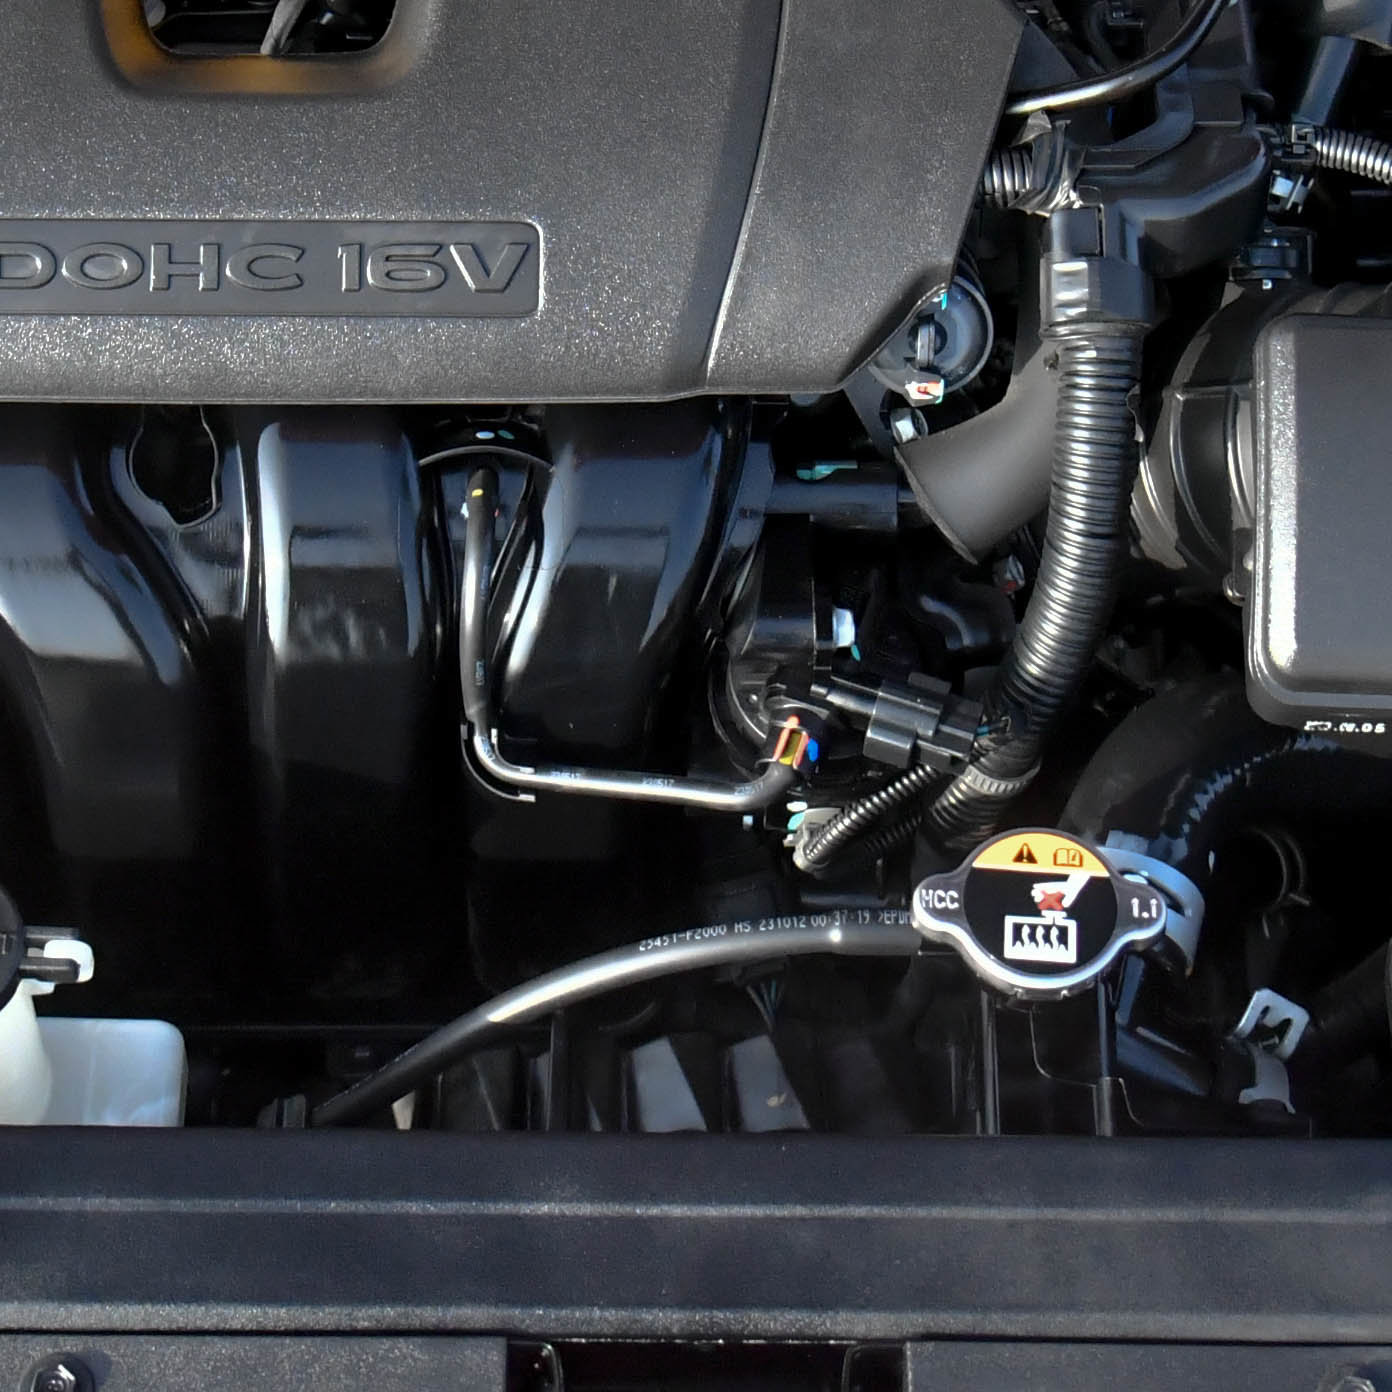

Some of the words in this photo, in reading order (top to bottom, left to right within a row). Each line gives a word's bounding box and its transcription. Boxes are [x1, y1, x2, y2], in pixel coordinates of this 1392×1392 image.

[337, 240, 533, 295] 16V
[920, 888, 960, 910] HCC
[1129, 897, 1159, 919] 1.1
